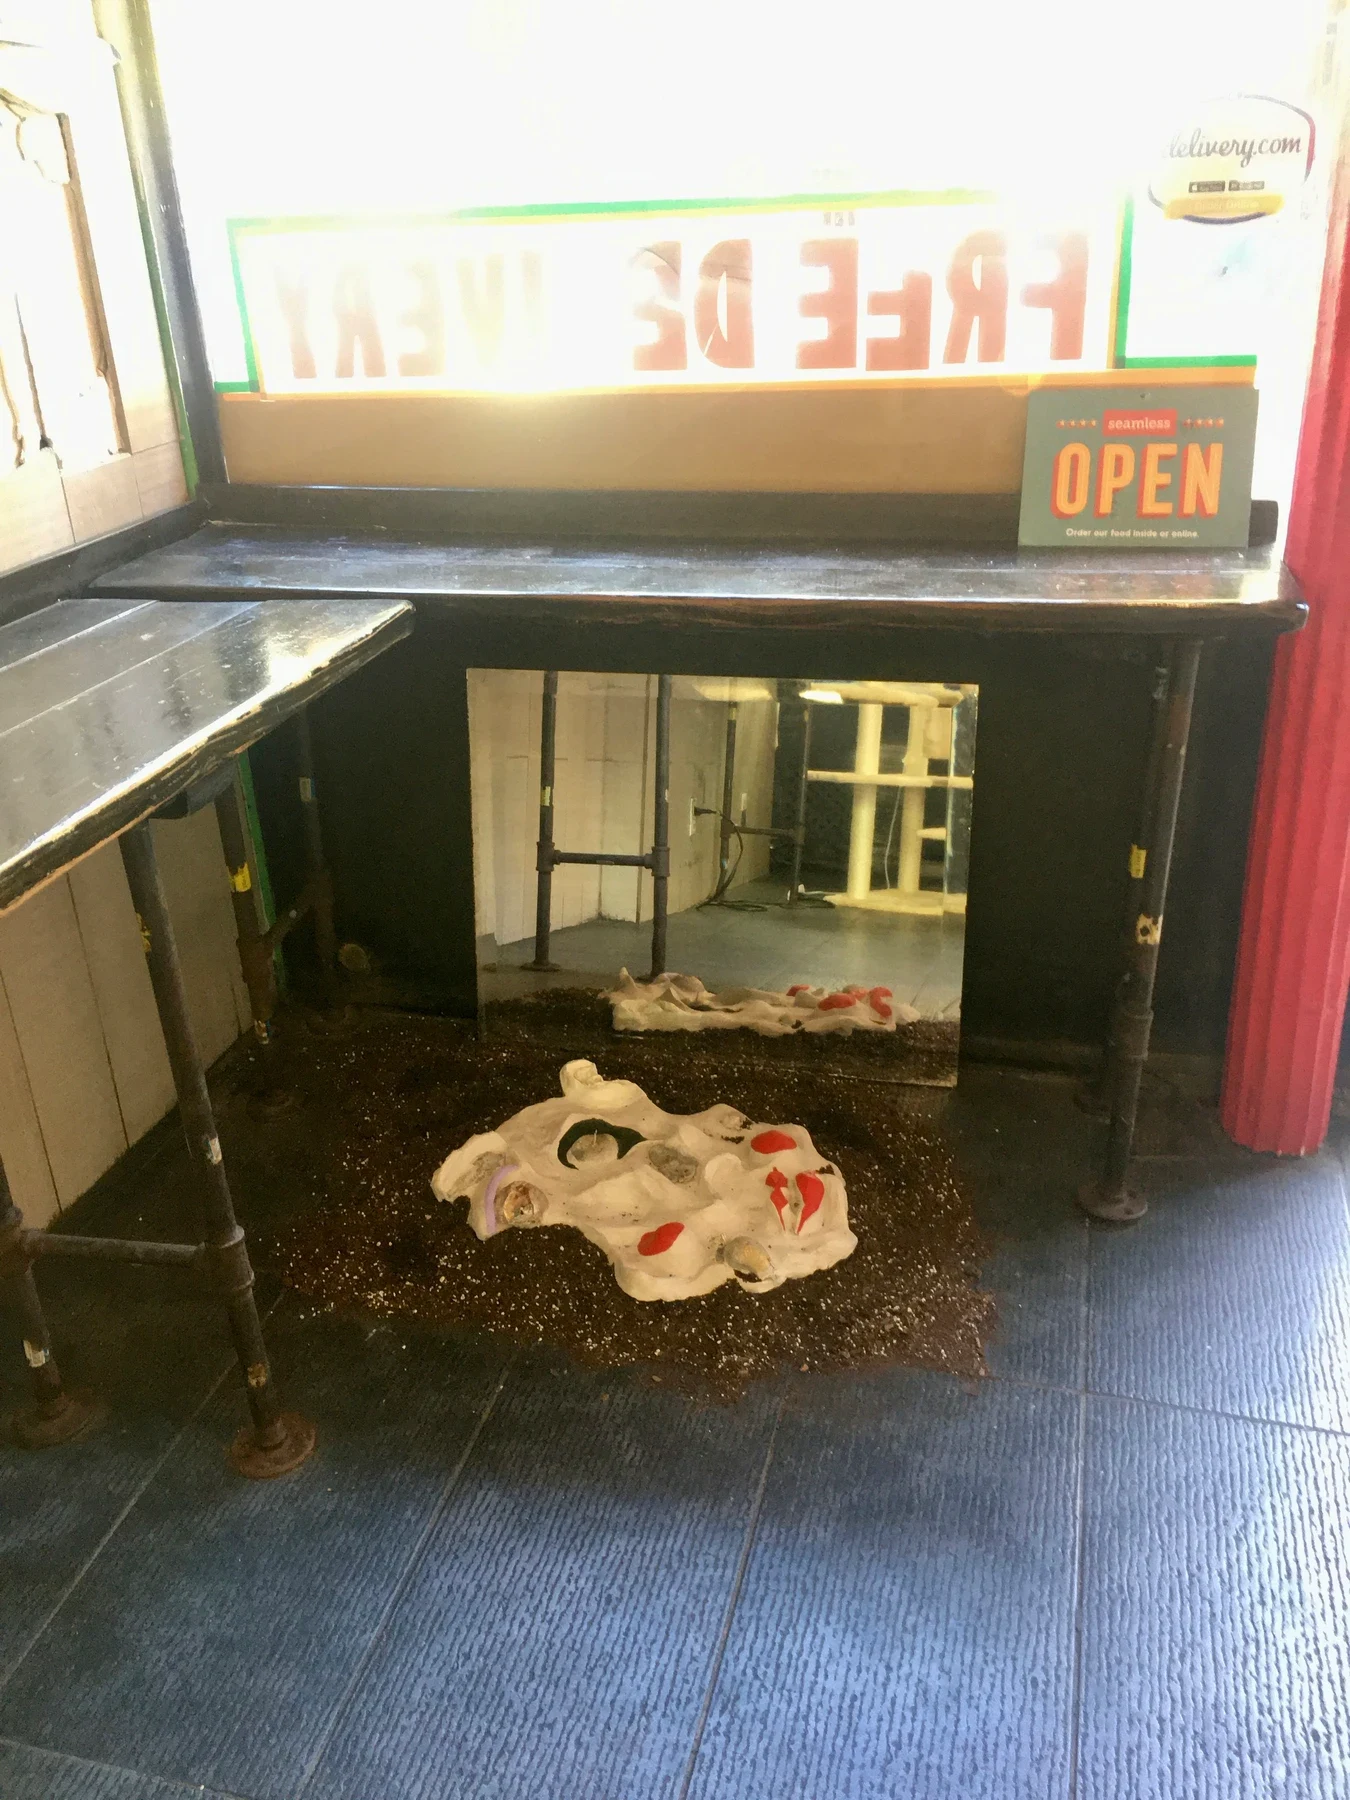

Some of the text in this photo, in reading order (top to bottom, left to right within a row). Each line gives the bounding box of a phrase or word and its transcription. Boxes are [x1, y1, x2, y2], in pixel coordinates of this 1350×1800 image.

[1107, 416, 1171, 431] seamless
[1051, 442, 1224, 519] OPEN
[1065, 527, 1092, 537] Order
[1110, 528, 1131, 537] food
[1133, 529, 1157, 538] inside
[1159, 530, 1169, 538] or
